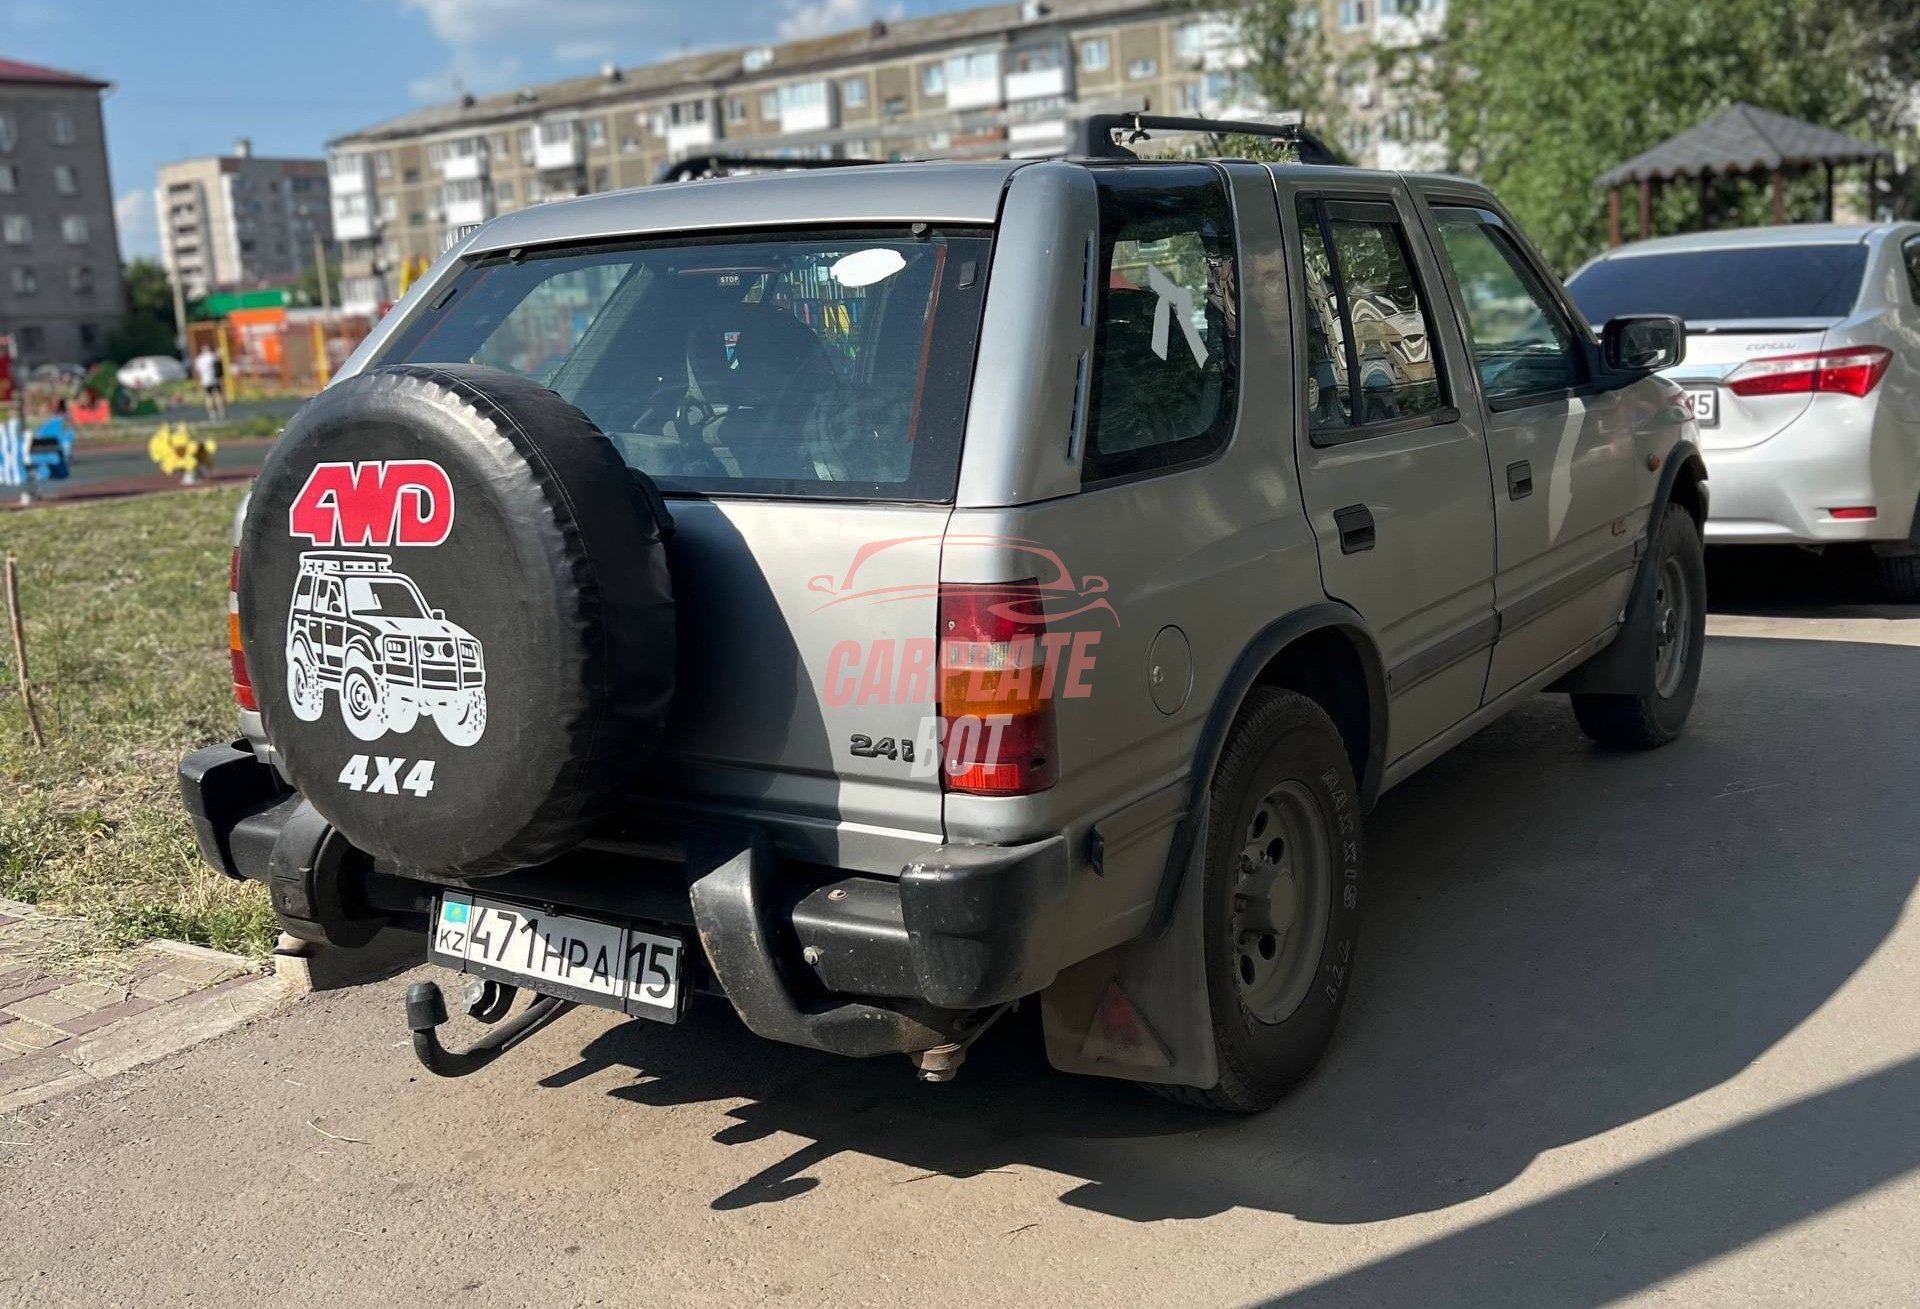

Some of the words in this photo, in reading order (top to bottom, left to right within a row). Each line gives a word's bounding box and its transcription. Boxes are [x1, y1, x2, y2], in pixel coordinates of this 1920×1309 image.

[289, 459, 454, 546] 4WD
[338, 754, 435, 797] 4X4
[1321, 767, 1358, 909] MAXXIS
[439, 929, 464, 952] KZ
[628, 942, 675, 998] 15
